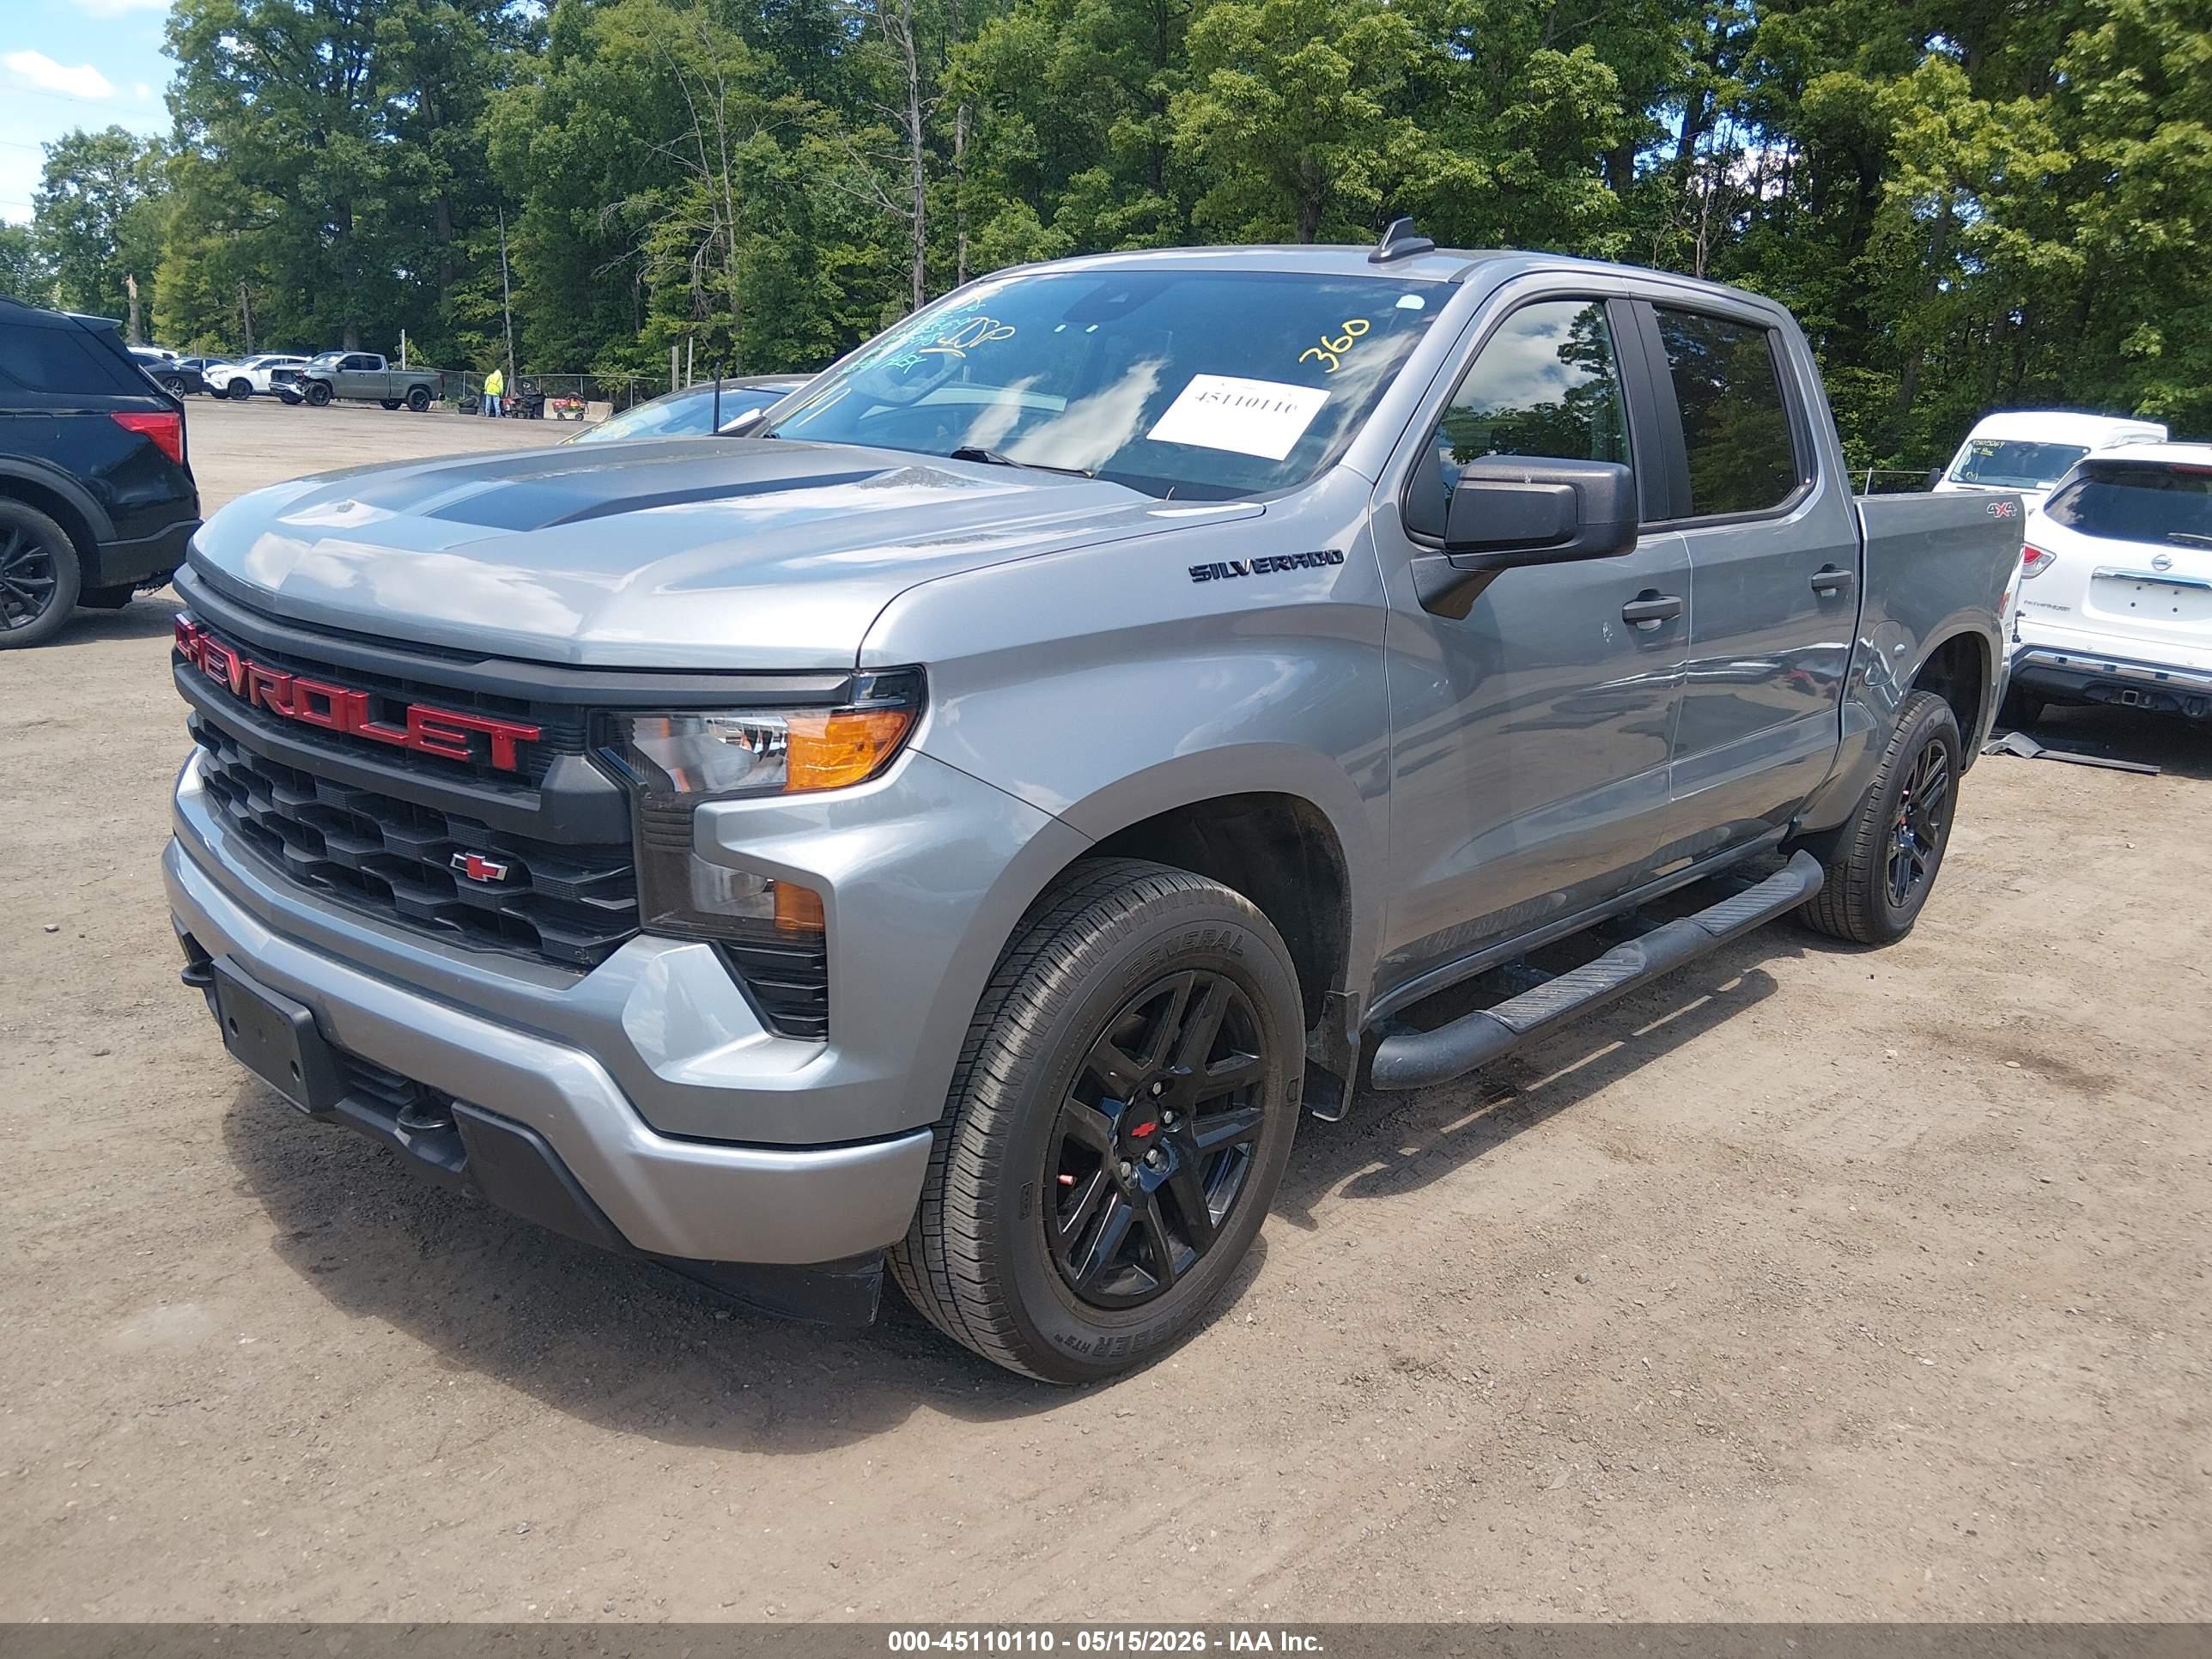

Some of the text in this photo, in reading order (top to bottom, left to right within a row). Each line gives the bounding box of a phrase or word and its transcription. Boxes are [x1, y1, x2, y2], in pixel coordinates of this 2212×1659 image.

[1298, 319, 1370, 374] 360
[1188, 549, 1345, 583] SILVERADO
[174, 612, 541, 771] CHEVROLET
